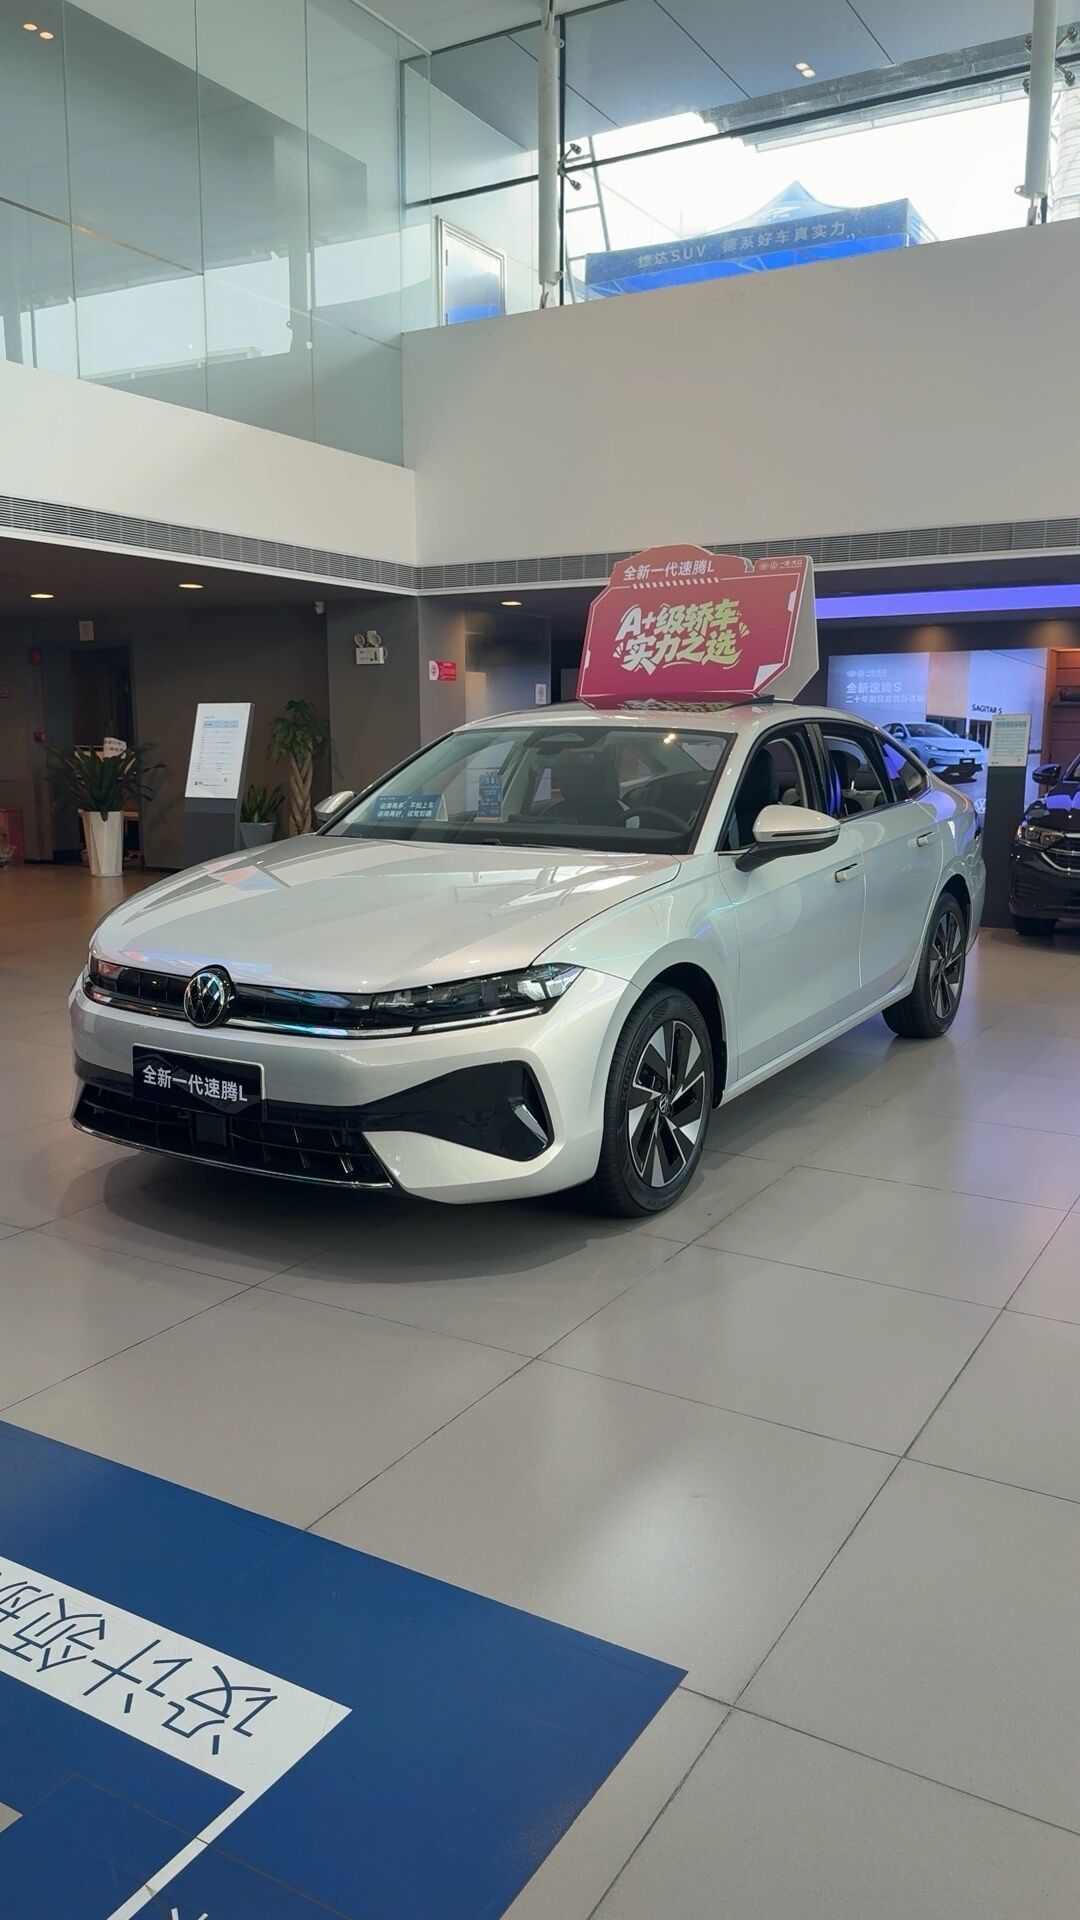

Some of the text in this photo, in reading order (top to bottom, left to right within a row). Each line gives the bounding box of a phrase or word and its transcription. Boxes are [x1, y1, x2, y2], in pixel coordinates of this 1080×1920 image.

[623, 559, 715, 582] 全新一代速腾L
[615, 599, 741, 641] A+级轿车
[619, 630, 744, 676] 实力之选
[142, 1064, 248, 1103] 全新一代速腾L
